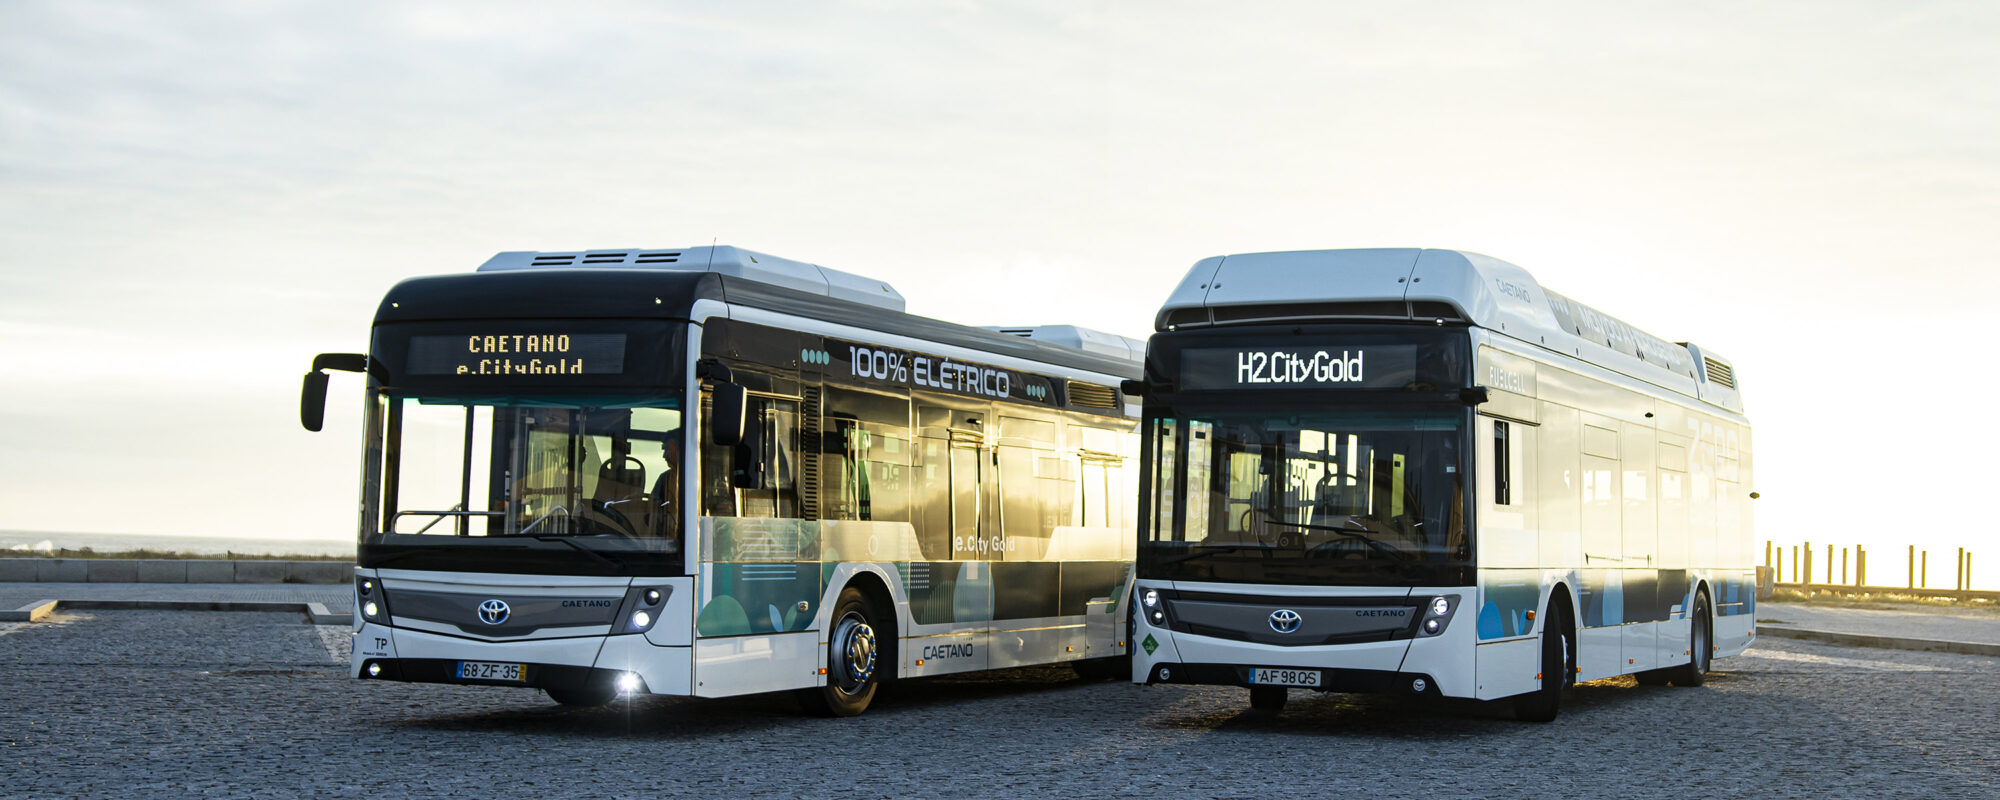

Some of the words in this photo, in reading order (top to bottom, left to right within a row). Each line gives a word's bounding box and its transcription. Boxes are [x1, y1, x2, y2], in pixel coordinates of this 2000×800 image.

[1495, 278, 1531, 303] CAETANO
[468, 334, 570, 353] CAETANO
[456, 358, 583, 375] e.CityGold
[849, 345, 908, 383] 100%
[913, 355, 1010, 398] ELÉTRICO
[1237, 350, 1364, 383] H2.CityGold
[561, 600, 611, 608] CAETANO
[375, 637, 388, 650] TP
[923, 643, 973, 661] CAETANO
